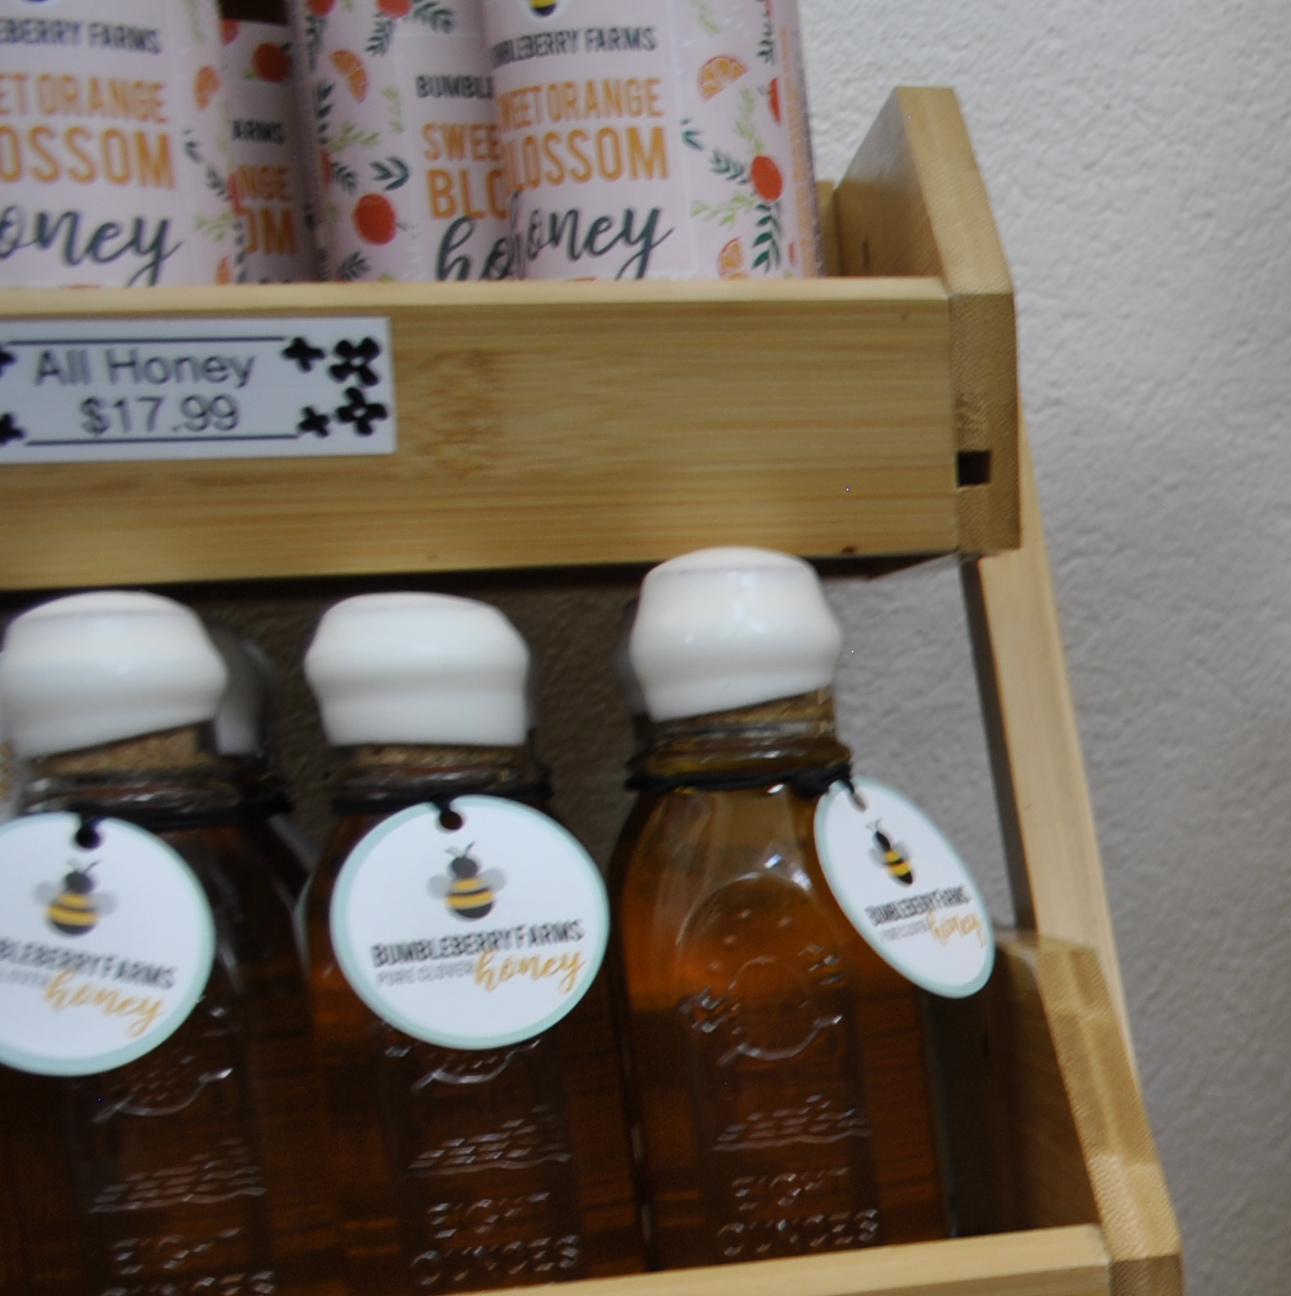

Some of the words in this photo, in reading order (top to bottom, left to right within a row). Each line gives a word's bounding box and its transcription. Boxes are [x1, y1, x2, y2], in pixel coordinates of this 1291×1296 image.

[89, 21, 162, 55] FARMS
[584, 26, 657, 52] FARMS
[36, 73, 168, 124] ORANGE
[547, 77, 664, 122] ORANGE
[231, 118, 286, 145] ARMS
[422, 122, 500, 162] SWEE
[36, 350, 92, 387] All
[107, 349, 254, 389] Honey
[81, 396, 239, 438] $17.99
[371, 924, 512, 968] BUMBLEBERRY
[513, 918, 586, 950] FARMS
[101, 953, 178, 991] FARMS
[472, 949, 588, 994] honey
[43, 966, 167, 1038] honey
